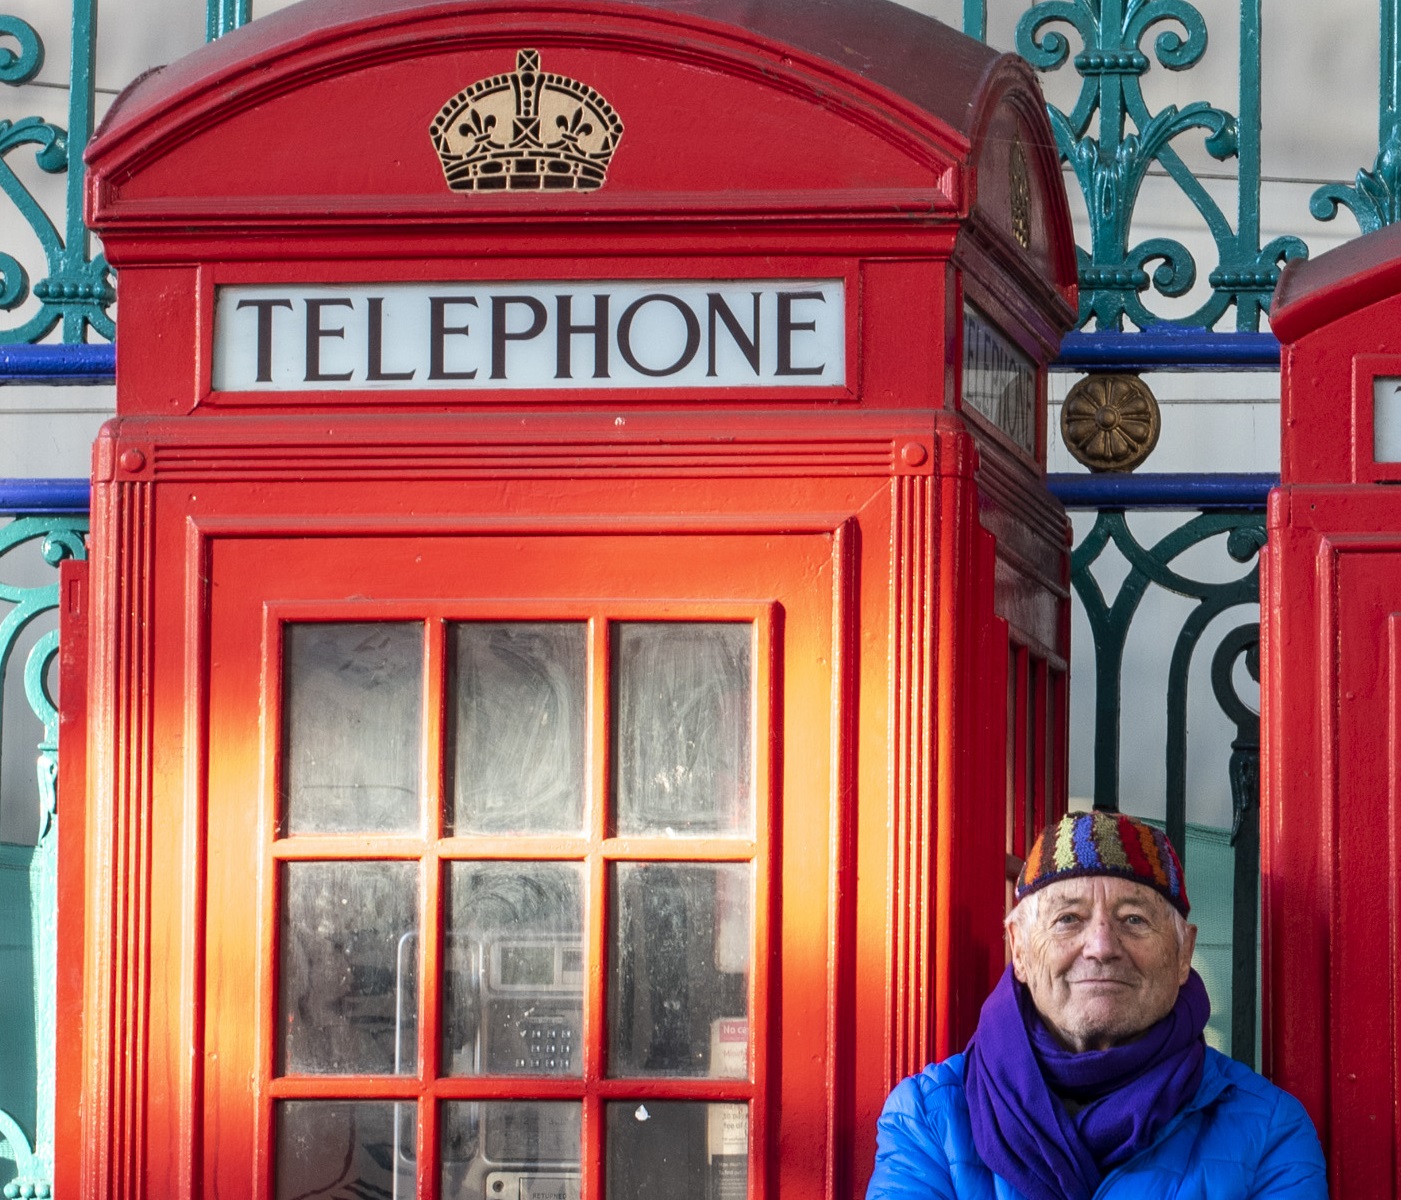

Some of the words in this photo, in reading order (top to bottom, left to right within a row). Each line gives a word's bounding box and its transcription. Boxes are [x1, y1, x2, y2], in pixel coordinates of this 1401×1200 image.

[236, 291, 826, 383] TELEPHONE
[965, 314, 1034, 452] ELEPHONE
[723, 1024, 736, 1034] No
[532, 1192, 567, 1200] RETURNED
